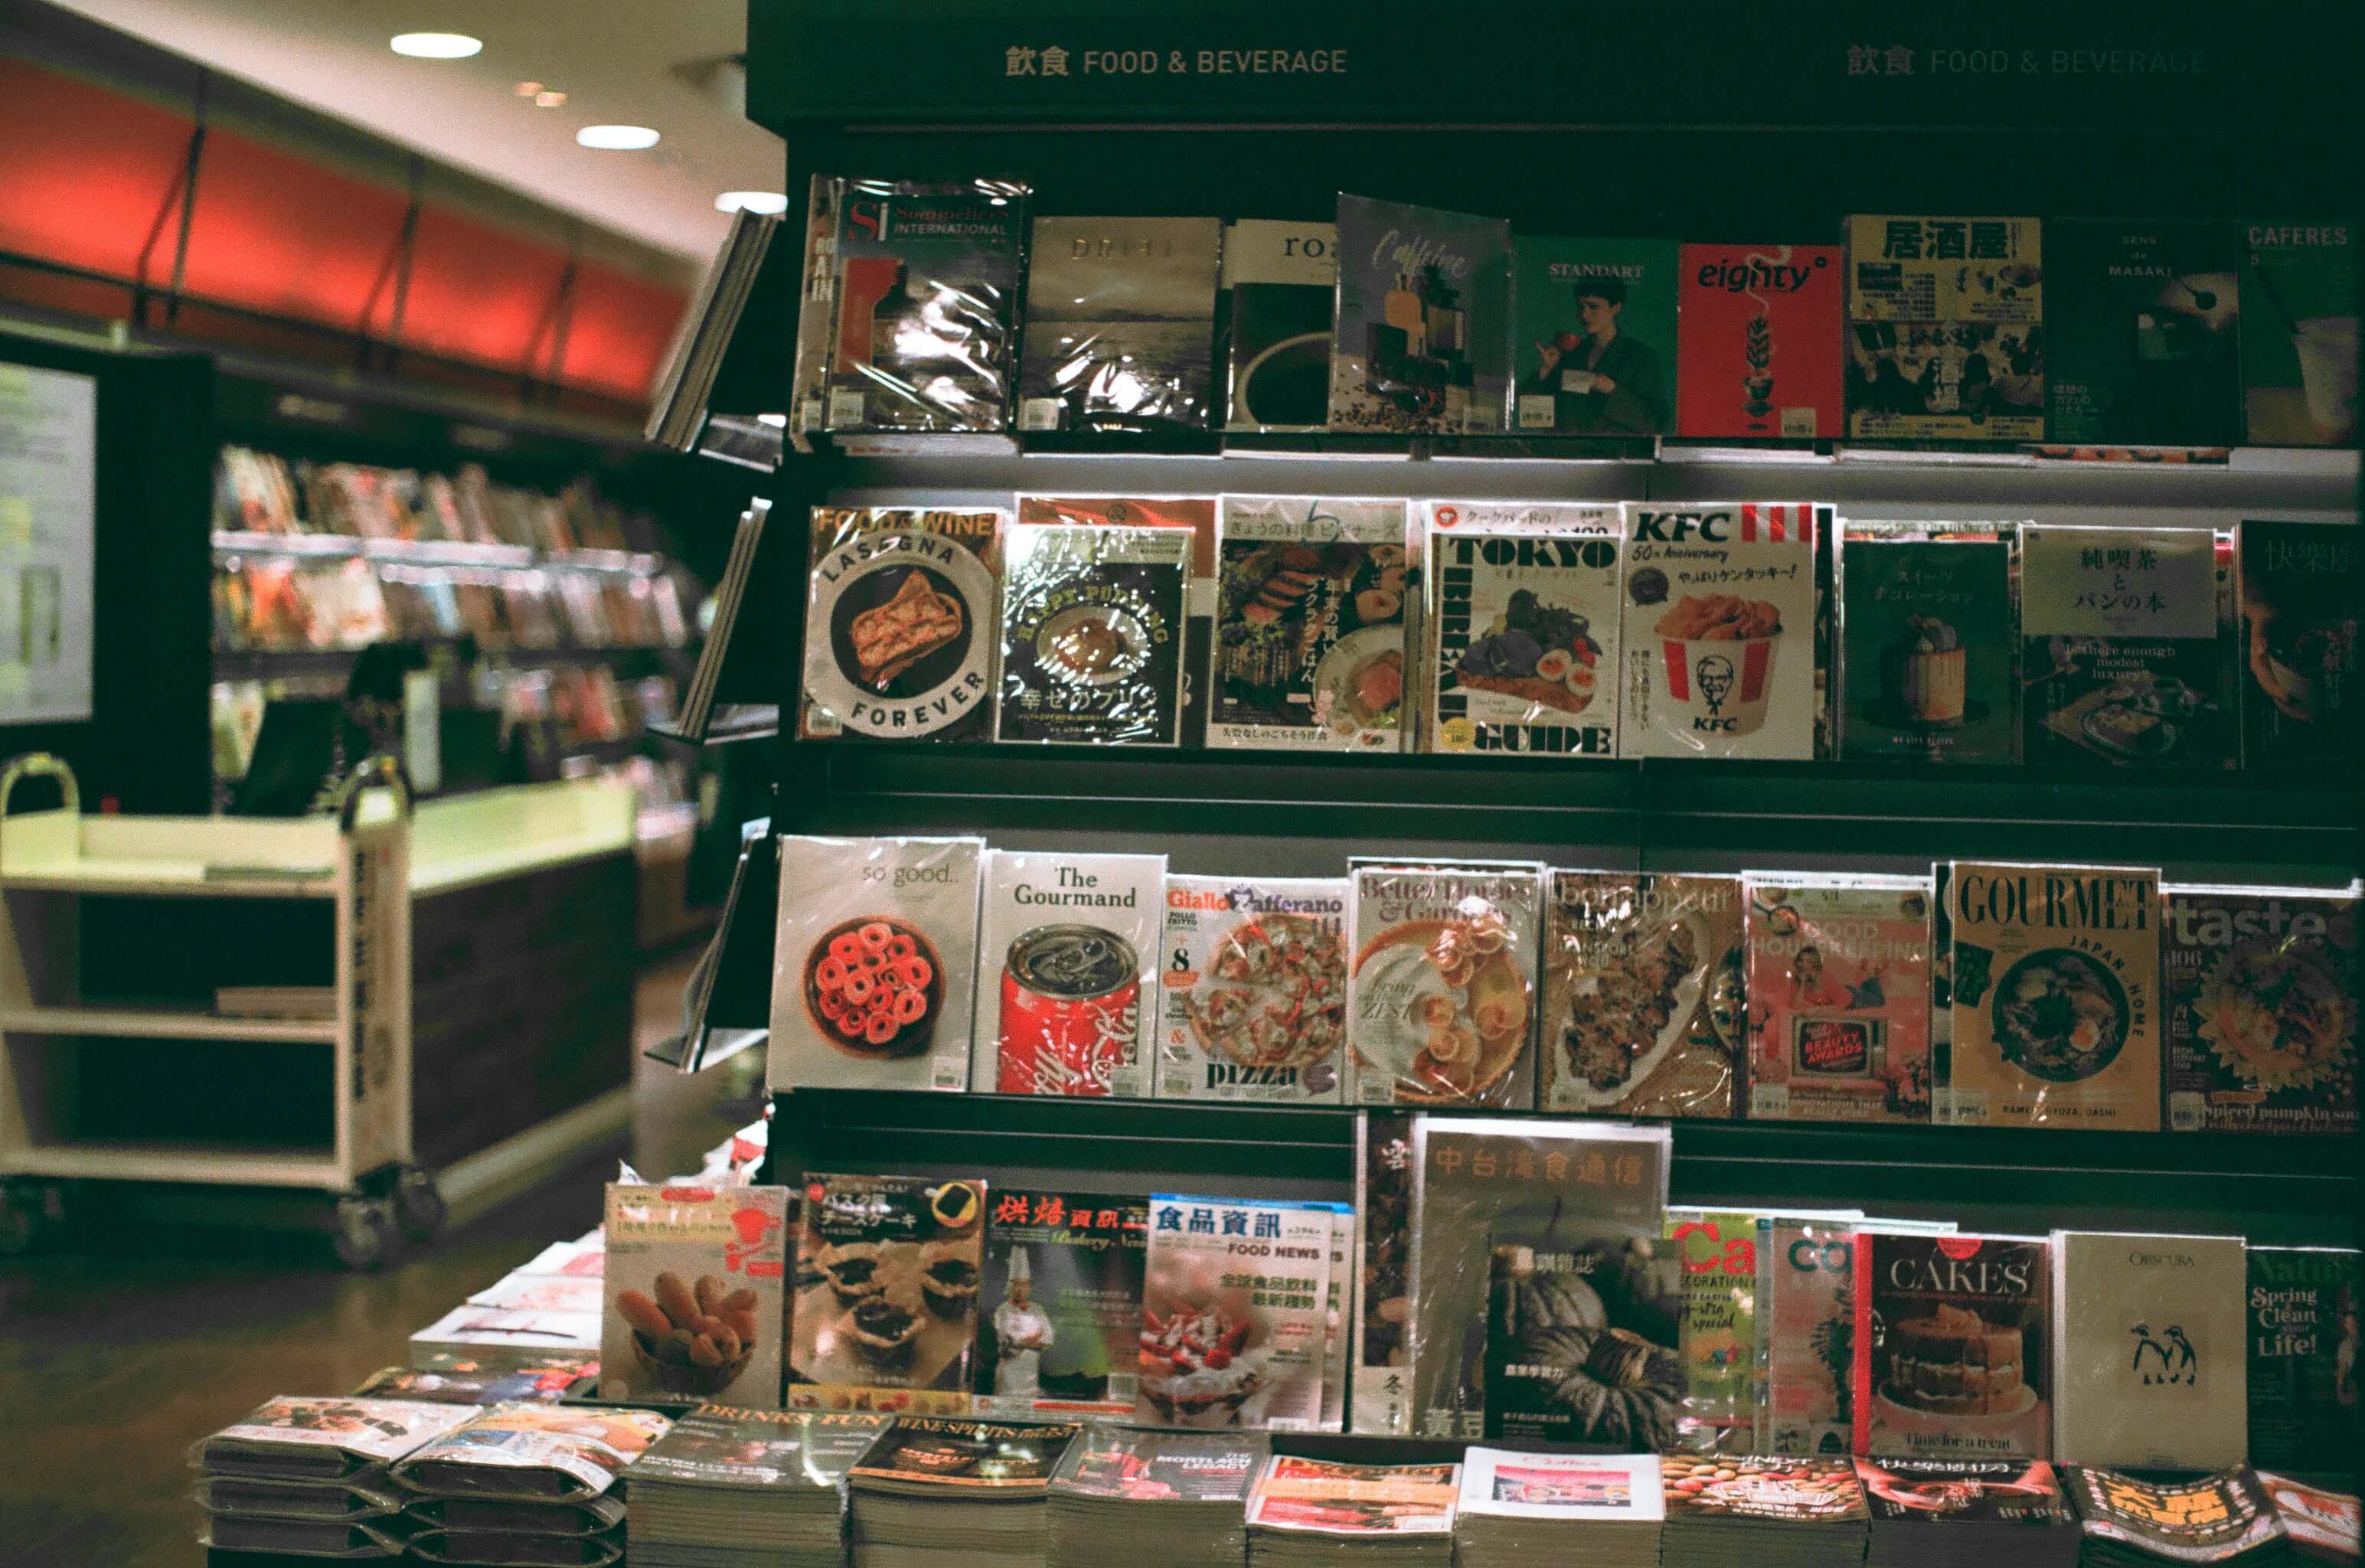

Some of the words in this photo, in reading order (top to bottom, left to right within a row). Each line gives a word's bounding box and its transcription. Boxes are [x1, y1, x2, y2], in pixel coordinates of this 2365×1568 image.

[1005, 45, 1070, 77] 飲食
[1083, 51, 1158, 74] FOOD
[1168, 51, 1187, 74] &
[1197, 50, 1347, 74] BEVERAGE
[1847, 44, 1914, 75] 飲食
[1930, 50, 2010, 74] FOOD
[2020, 51, 2040, 74] &
[2052, 50, 2207, 74] BEVERAGE
[894, 223, 1008, 236] INTERNATIONAL
[1883, 220, 2009, 260] 居酒屋
[2248, 226, 2348, 246] CAFERES
[1548, 262, 1644, 278] STANDART
[2108, 265, 2172, 277] MASAKI
[1632, 512, 1731, 543] KFC
[1449, 537, 1616, 568] TOKYO
[2080, 547, 2158, 572] 純喫茶
[2113, 573, 2126, 591] と
[2074, 590, 2167, 613] パンの本
[1086, 585, 1169, 644] PUDDNG
[2096, 658, 2146, 668] modest
[2122, 645, 2176, 659] enough
[851, 671, 985, 727] FOREVER
[1020, 688, 1158, 710] 幸せのプリン
[1693, 716, 1738, 732] KFC
[1474, 724, 1612, 754] GUIDE
[861, 865, 887, 882] so
[893, 863, 957, 888] good.
[1054, 866, 1099, 888] The
[1014, 884, 1137, 908] Gourmand
[1166, 888, 1230, 912] Giallo
[1960, 873, 2154, 931] GOURMET
[2162, 898, 2327, 948] taste
[1171, 947, 1190, 972] 8
[2069, 933, 2126, 972] JAPAN
[1805, 1032, 1860, 1054] BEAUTY
[1807, 1042, 1864, 1065] AWARDS
[1206, 1063, 1297, 1089] pizza
[1155, 1205, 1282, 1239] 食品資訊
[1227, 1243, 1271, 1256] FOOD
[1275, 1246, 1320, 1260] NEWS
[1890, 1259, 2031, 1295] CAKES
[2249, 1285, 2318, 1309] Spring
[2258, 1306, 2319, 1329] Clean
[2258, 1333, 2318, 1357] Life!
[697, 1402, 813, 1425] DRINKS
